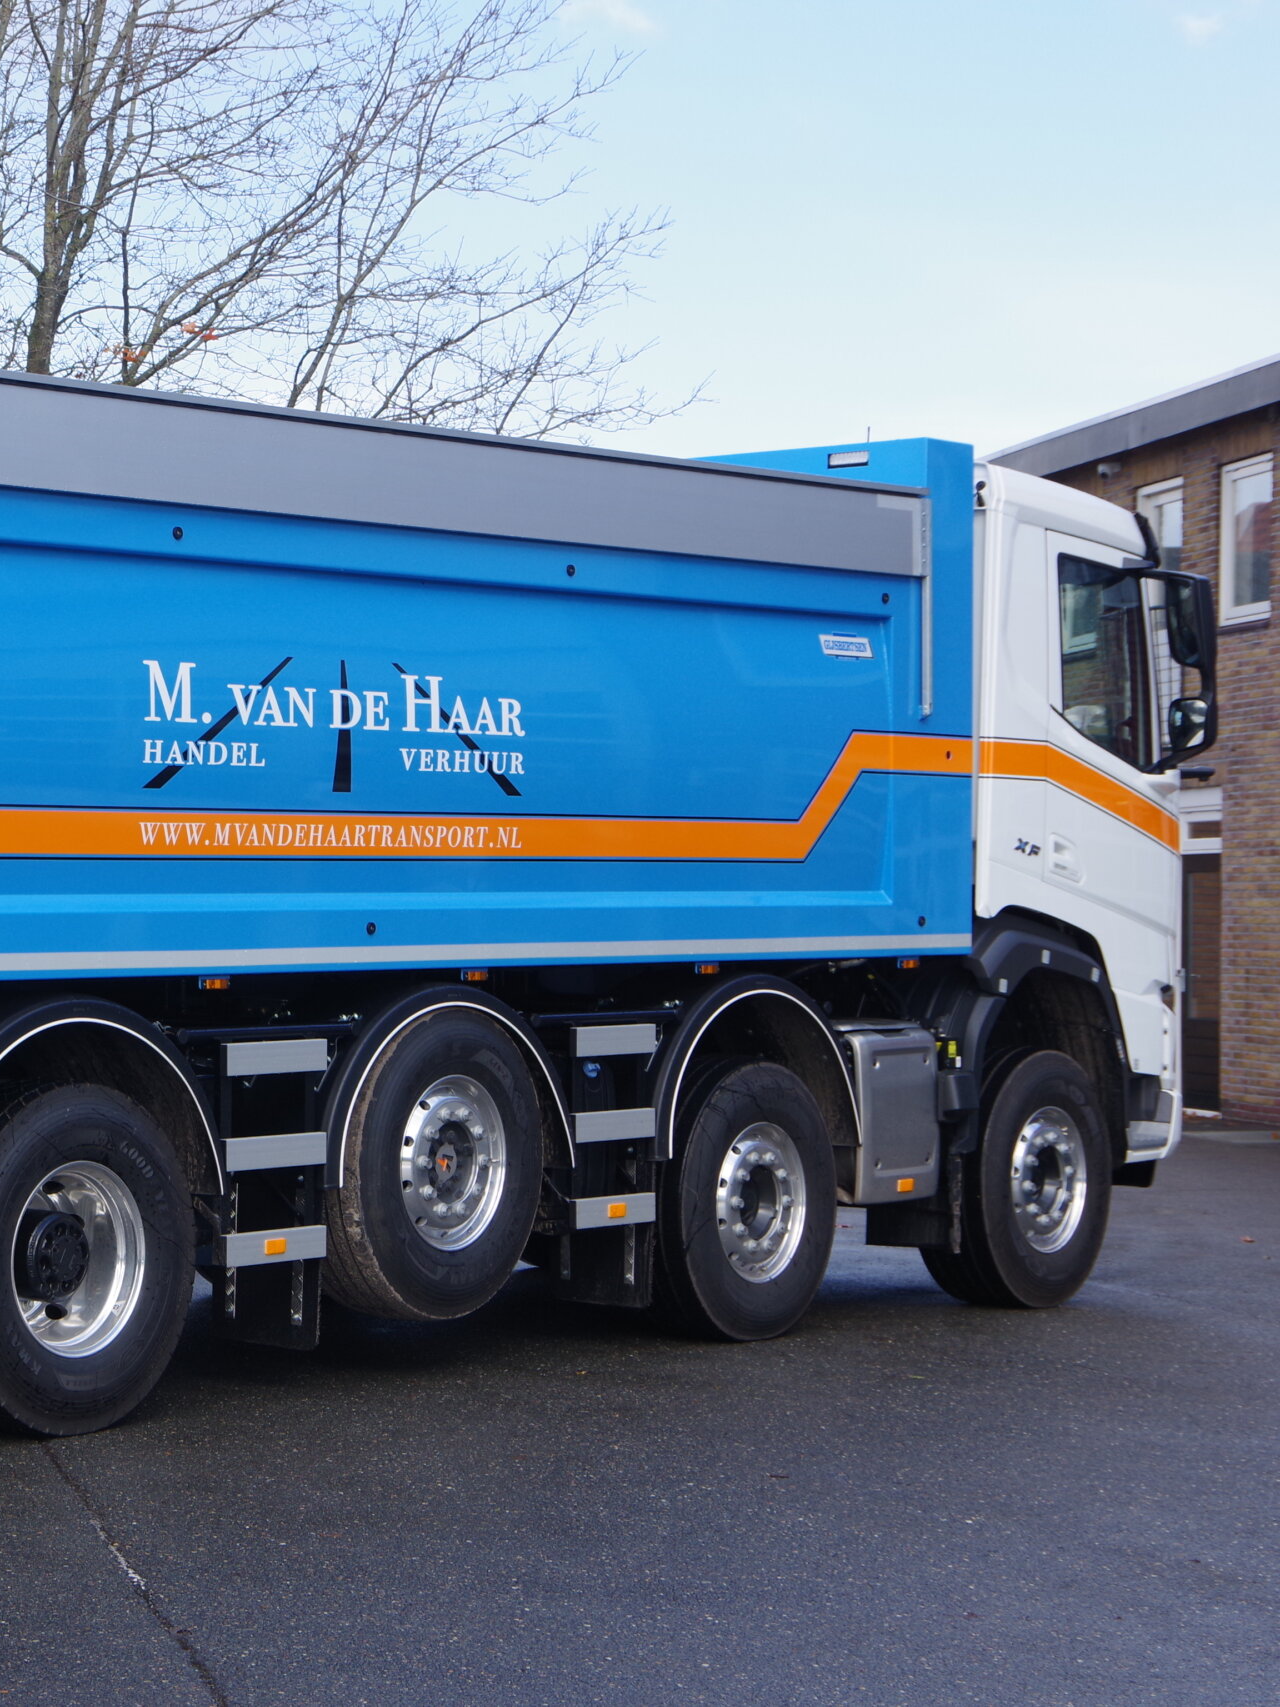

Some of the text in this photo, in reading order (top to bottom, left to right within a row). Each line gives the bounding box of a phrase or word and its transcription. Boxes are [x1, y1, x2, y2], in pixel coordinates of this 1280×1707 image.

[142, 659, 526, 737] M. VAN DE HAAR
[142, 739, 266, 767] HANDEL
[400, 748, 526, 775] VERHUUR
[139, 821, 523, 849] WWW.MVANDEHAARTRANSPORT.NL
[1013, 837, 1042, 857] XF
